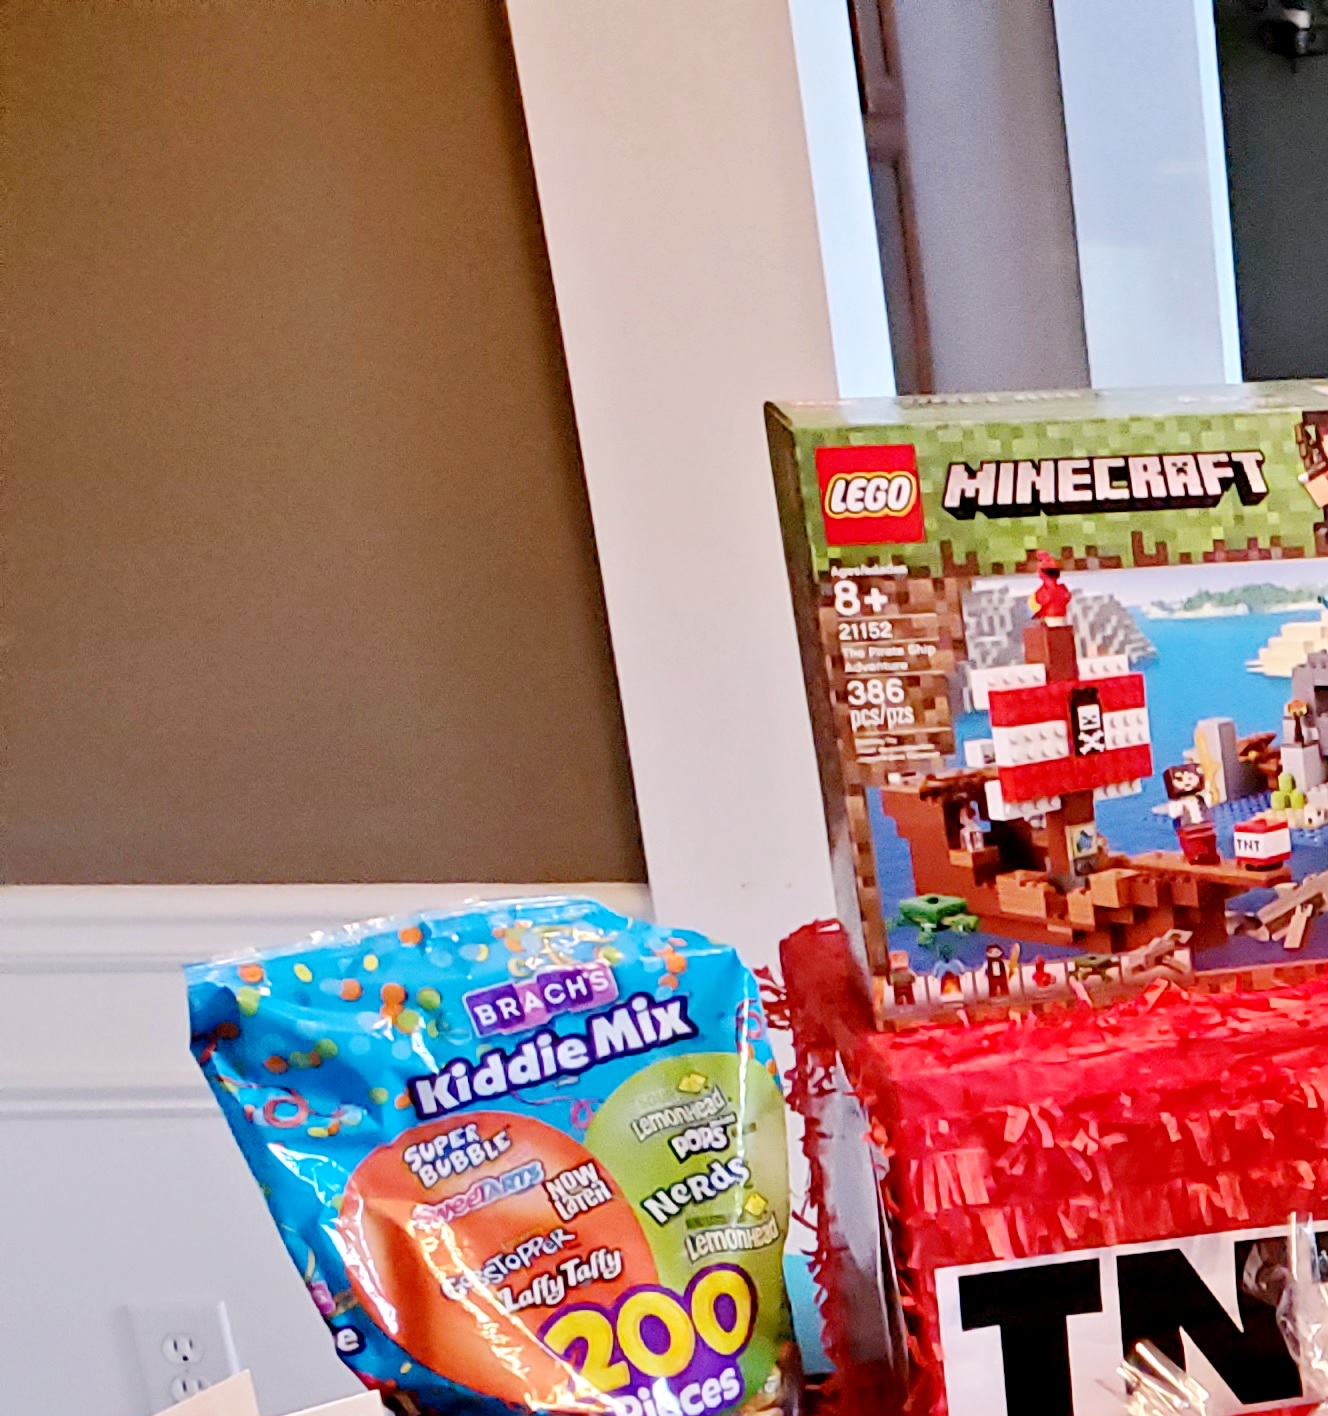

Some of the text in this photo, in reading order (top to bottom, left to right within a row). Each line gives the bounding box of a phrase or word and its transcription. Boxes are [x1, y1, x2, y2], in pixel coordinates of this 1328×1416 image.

[829, 451, 1269, 518] LEGO MINECRAFT
[834, 580, 888, 616] 8+
[838, 621, 893, 641] 21152
[847, 677, 905, 706] 386
[1237, 838, 1260, 853] TNT
[473, 970, 612, 1027] BRACH'S
[415, 997, 693, 1116] Kiddie Mix
[403, 1122, 480, 1173] SUPER
[418, 1130, 511, 1188] BUBBLE
[668, 1125, 730, 1163] POPS
[547, 1162, 600, 1199] NOW
[499, 1248, 624, 1314] Laffy Taffy
[544, 1269, 751, 1393] 200
